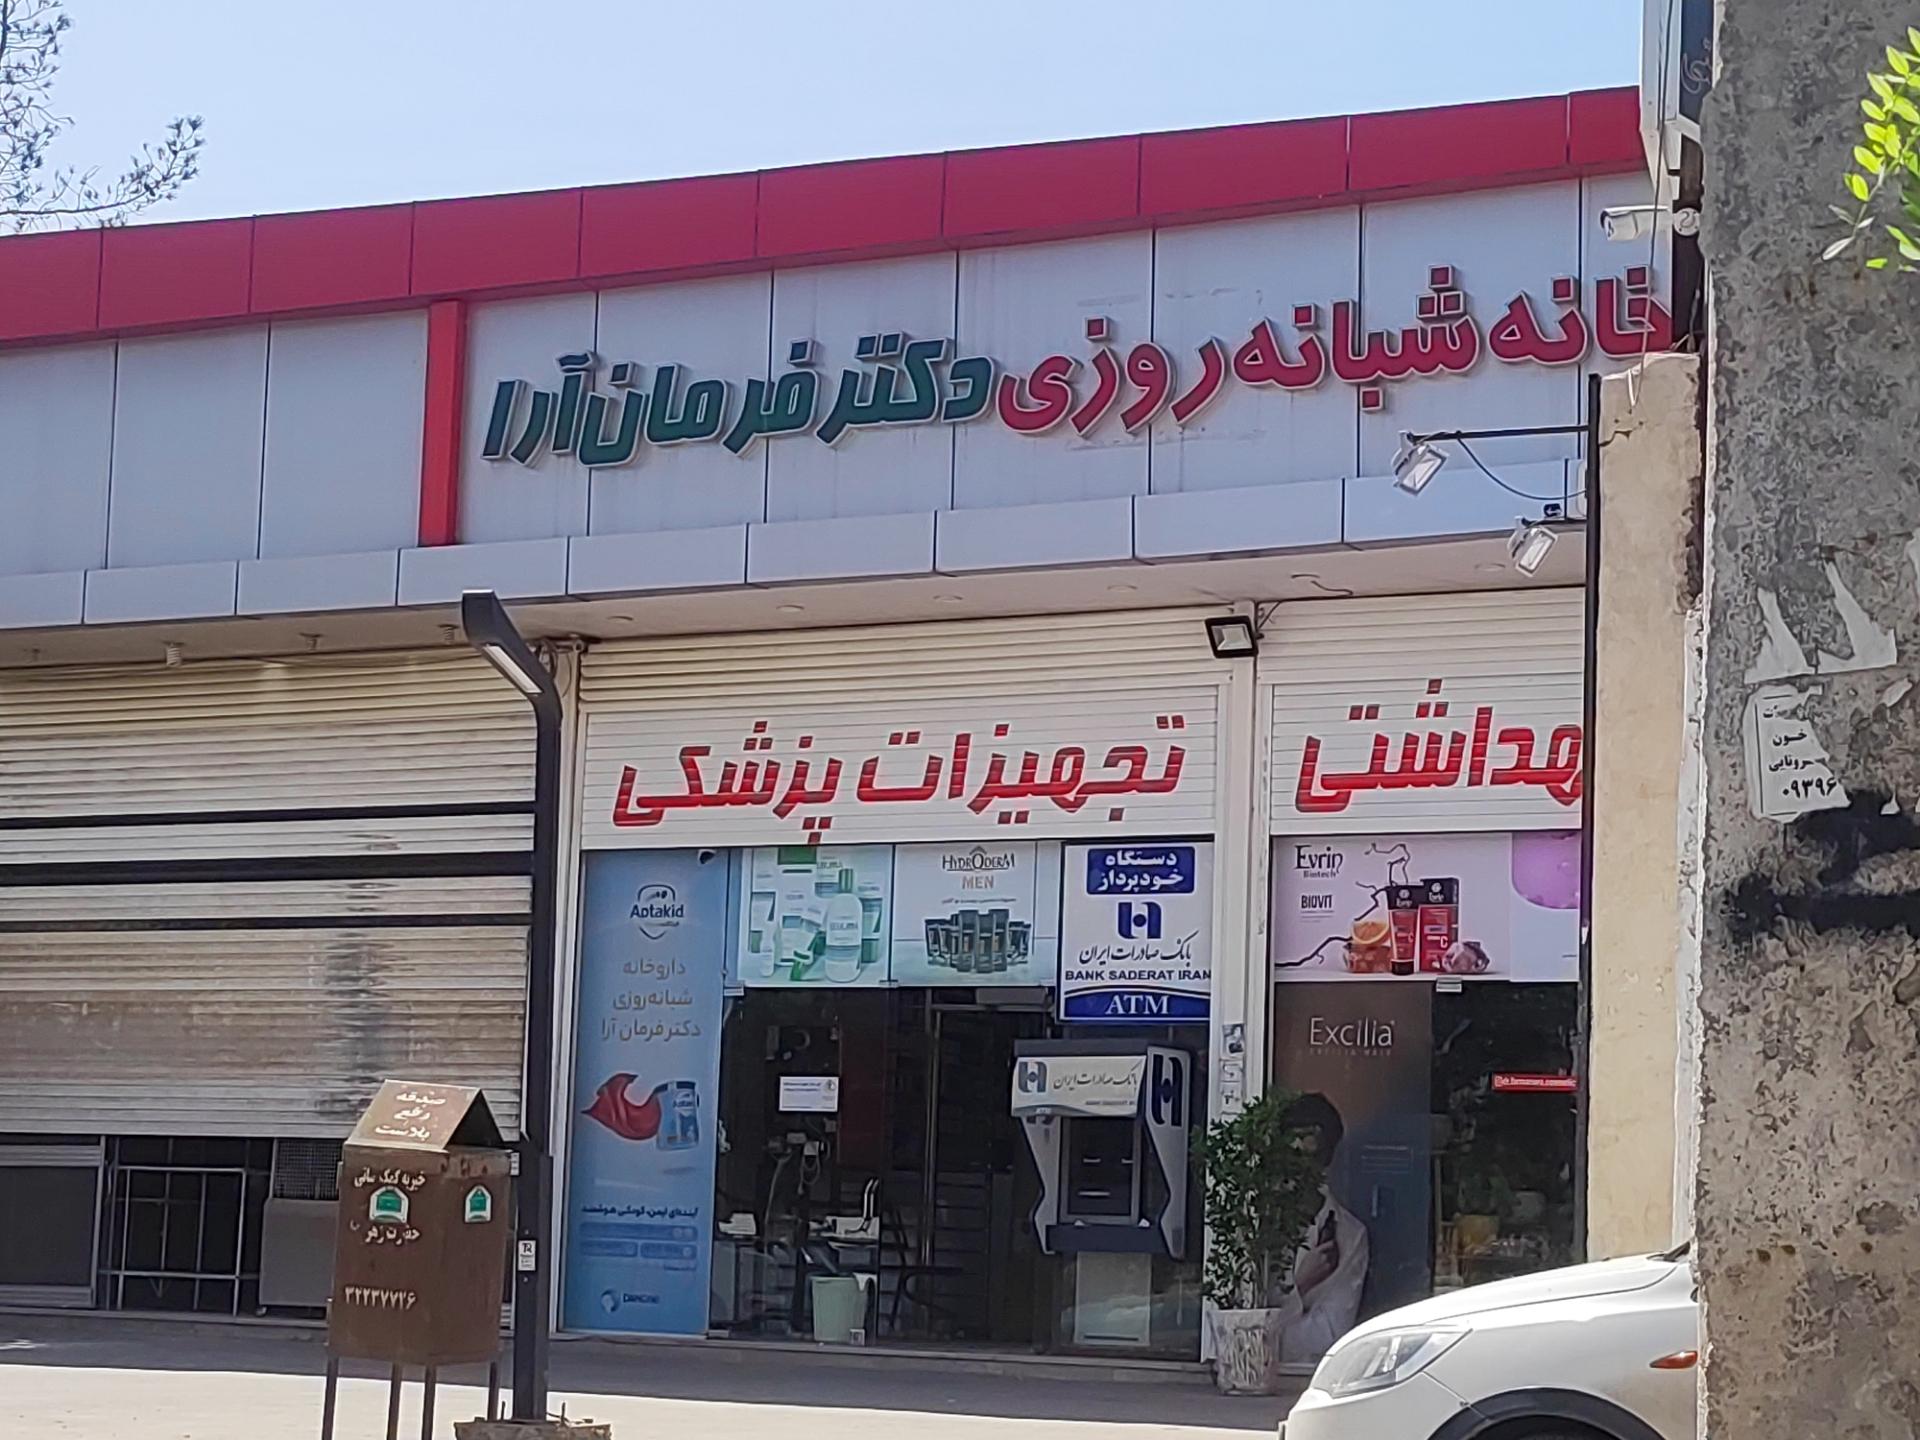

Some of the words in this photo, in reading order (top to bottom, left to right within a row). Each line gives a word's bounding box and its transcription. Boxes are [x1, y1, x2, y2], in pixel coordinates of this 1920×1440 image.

[815, 331, 997, 449] دکتر
[1295, 678, 1583, 814] هداشتی
[855, 714, 1187, 825] تجهیزات
[612, 720, 844, 845] پزشکی
[1105, 850, 1177, 866] دستگاه
[1294, 844, 1344, 873] Evrin
[962, 875, 994, 889] MEN
[1097, 868, 1184, 892] خودپرداز
[1079, 944, 1111, 966] ایران
[1111, 944, 1160, 961] صادرات
[1160, 930, 1200, 968] بانک
[623, 957, 686, 980] داروخانه
[1065, 970, 1105, 981] BANK
[1108, 970, 1175, 981] SADERAT
[1178, 970, 1212, 981] IRAN
[1105, 994, 1170, 1015] ATM
[664, 1019, 702, 1042] دکتر
